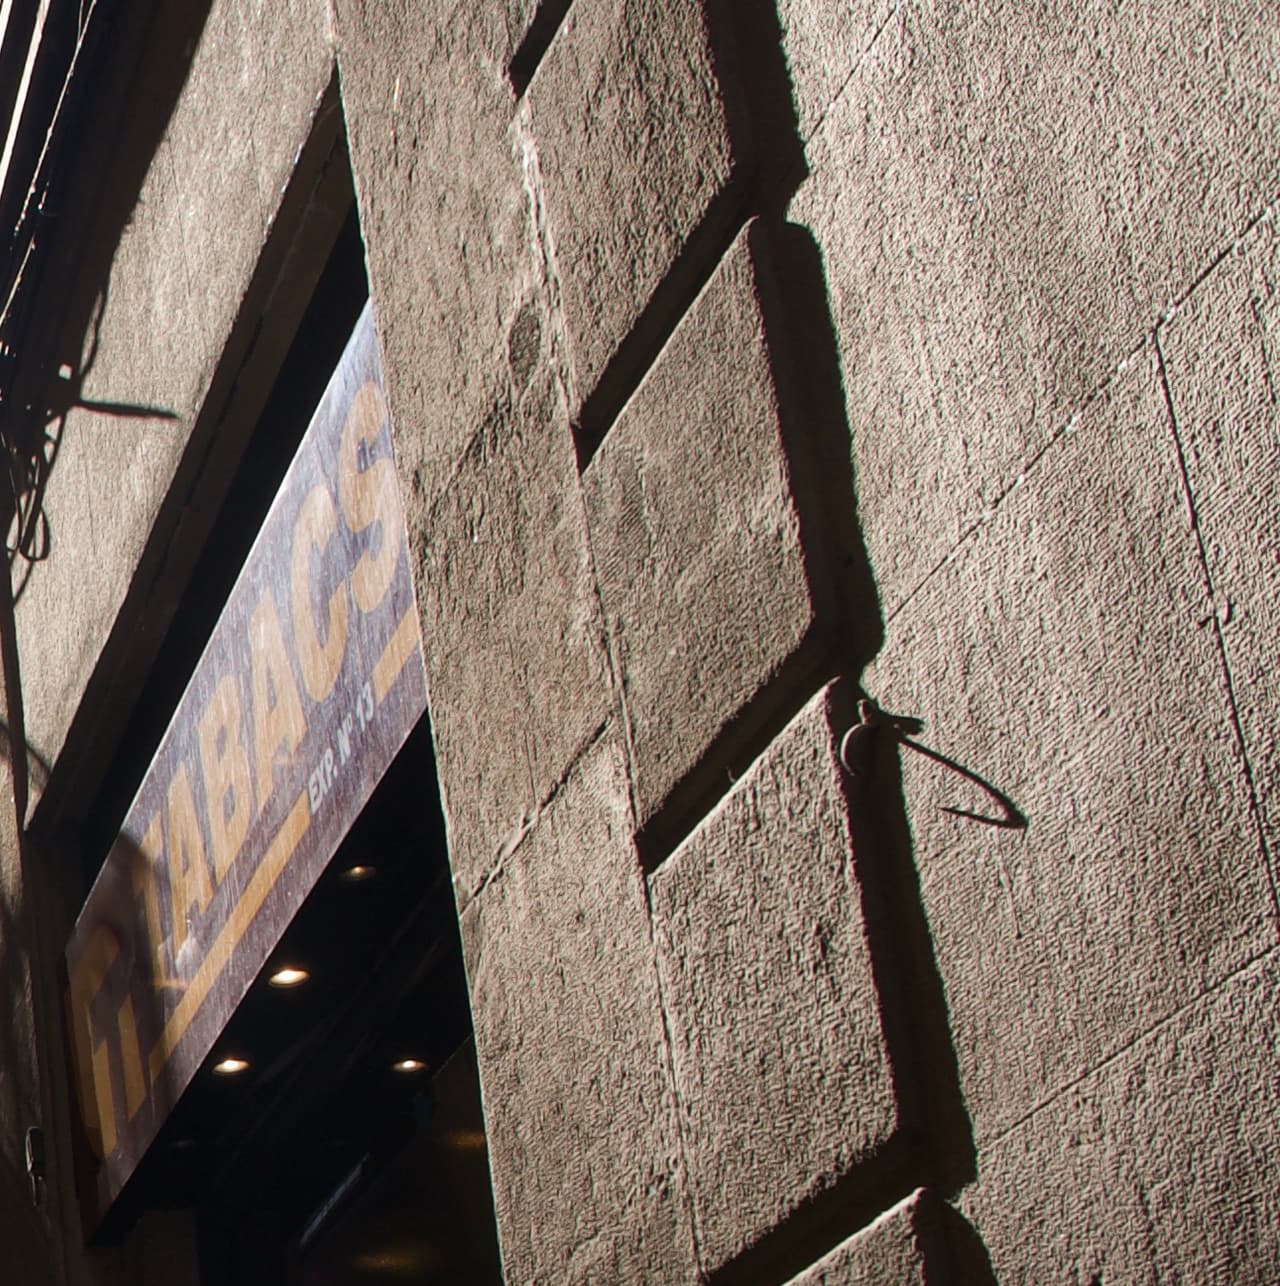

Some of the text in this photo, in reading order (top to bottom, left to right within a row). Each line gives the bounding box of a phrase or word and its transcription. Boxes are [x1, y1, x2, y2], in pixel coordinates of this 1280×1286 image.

[133, 380, 402, 990] TABACS
[308, 747, 338, 816] EXP.
[356, 681, 374, 732] 13
